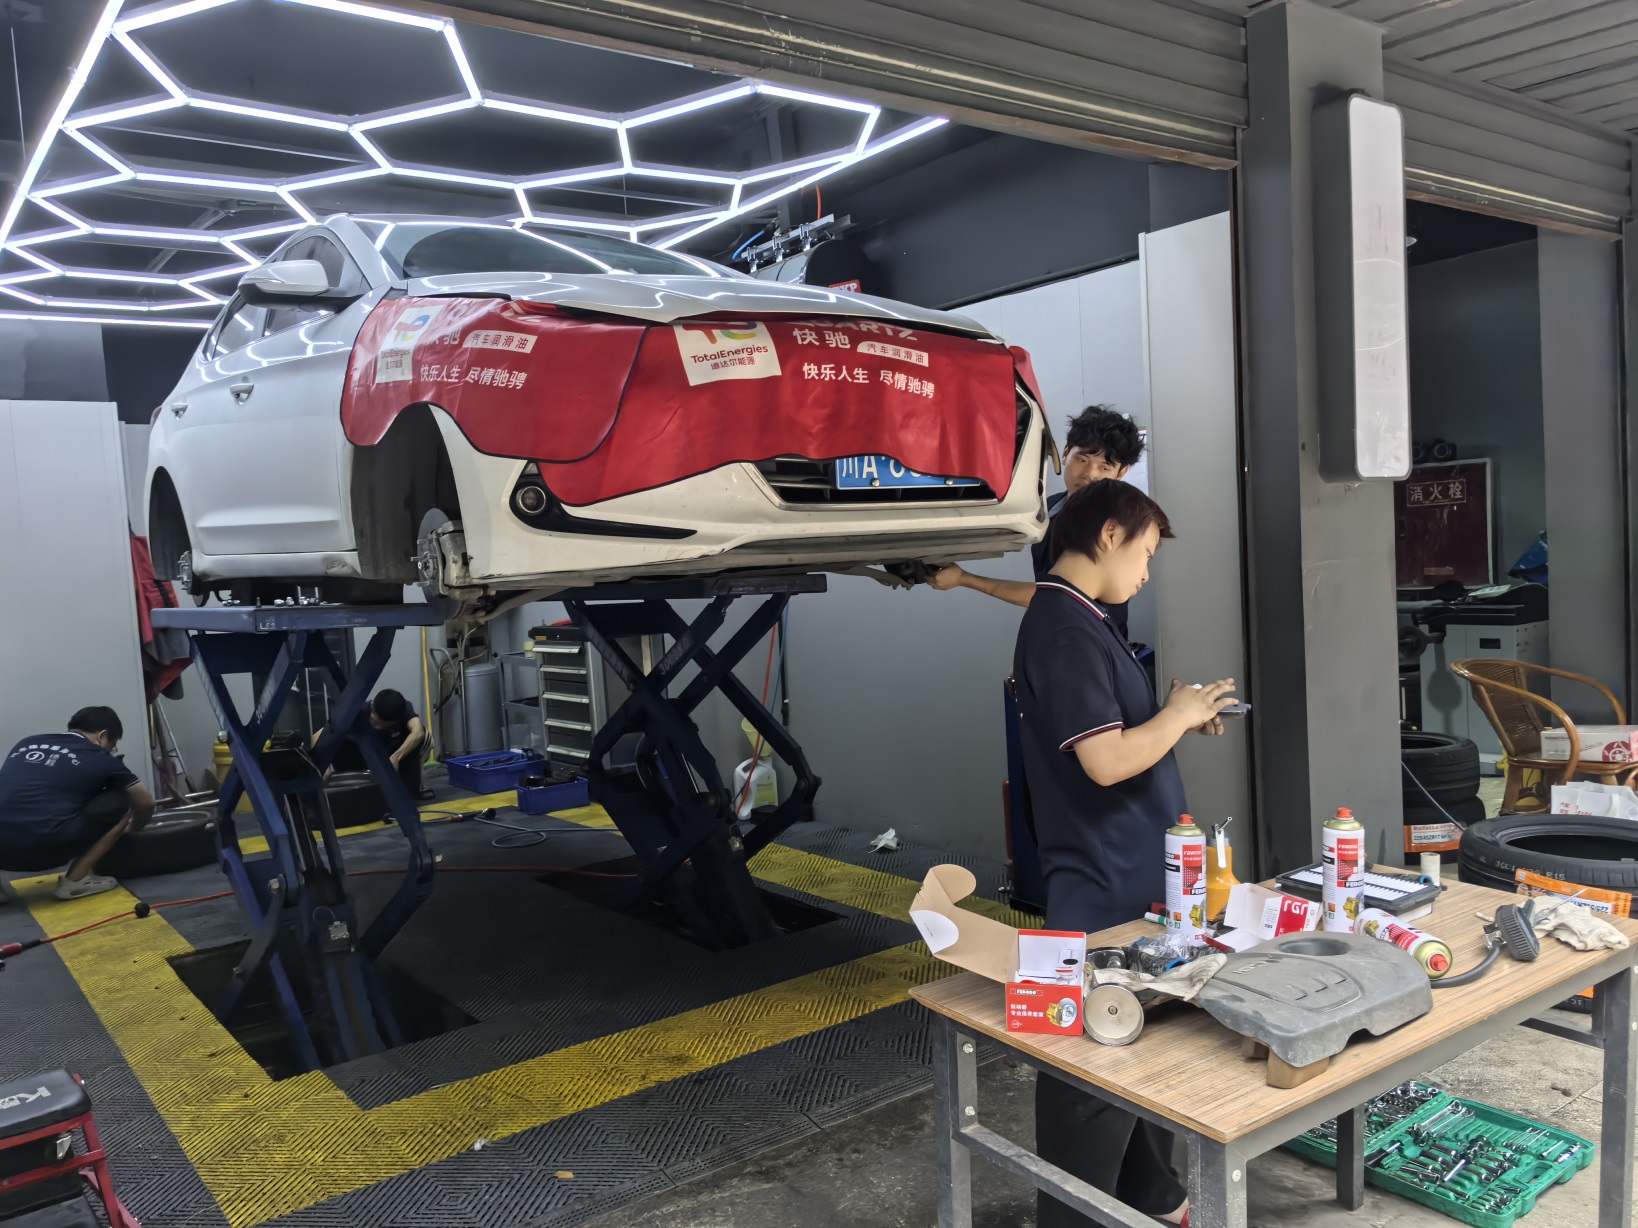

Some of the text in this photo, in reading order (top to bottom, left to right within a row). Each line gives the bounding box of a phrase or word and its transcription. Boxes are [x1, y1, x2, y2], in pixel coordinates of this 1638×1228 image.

[472, 333, 529, 350] 汽车润滑油
[793, 328, 851, 349] 快驰
[690, 344, 769, 364] TotalEnergies
[866, 342, 925, 364] 汽车润滑油
[711, 356, 756, 371] 道达尔能源
[420, 364, 461, 383] 快乐人生
[465, 366, 528, 390] 尽情驰骋
[803, 362, 935, 399] 快乐人生 尽情驰骋
[1410, 482, 1463, 502] 消火栓
